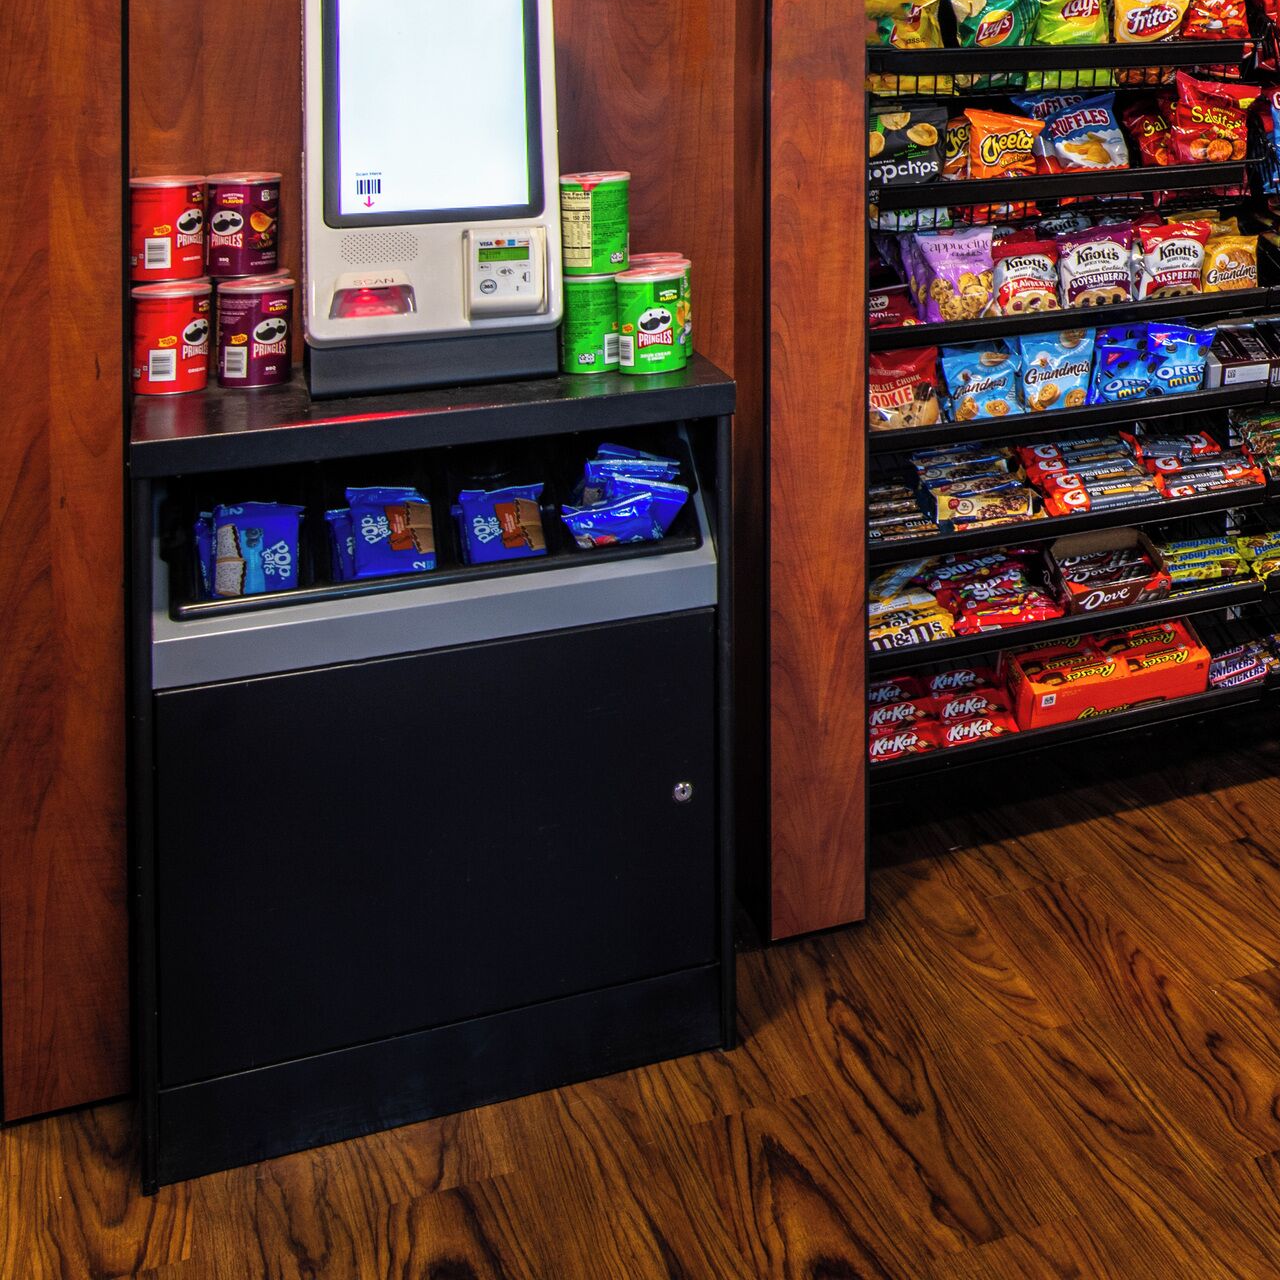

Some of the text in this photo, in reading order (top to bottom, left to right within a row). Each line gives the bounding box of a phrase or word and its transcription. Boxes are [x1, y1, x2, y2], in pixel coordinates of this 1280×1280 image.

[976, 14, 1011, 42] Lay's
[1125, 3, 1178, 34] Fritos
[1191, 104, 1243, 130] Salsitas
[211, 233, 243, 248] PRINGLES
[1075, 244, 1120, 266] Knott's
[1159, 243, 1199, 261] Knott's
[1005, 257, 1049, 272] Knott's
[353, 277, 395, 286] SCAN
[1002, 279, 1056, 294] STRAWBERRY
[1071, 271, 1131, 289] BOYSENBERRY
[637, 331, 673, 349] PRINGLES
[253, 341, 287, 359] PRINGLES
[1024, 361, 1091, 385] Grandma's
[1168, 373, 1201, 388] mini
[1080, 469, 1109, 478] PROTEIN
[1087, 485, 1115, 494] PROTEIN
[1178, 545, 1237, 562] Butterfinger
[413, 560, 426, 569] 2
[1143, 649, 1189, 669] Reese's
[1209, 657, 1255, 680] SNICKERS
[931, 672, 978, 691] KitKat
[1066, 662, 1117, 682] Reese's
[1221, 665, 1266, 688] SNICKERS
[871, 704, 918, 724] KitKat
[944, 699, 988, 720] KitKat
[950, 721, 994, 740] KitKat
[873, 735, 919, 756] KitKat
